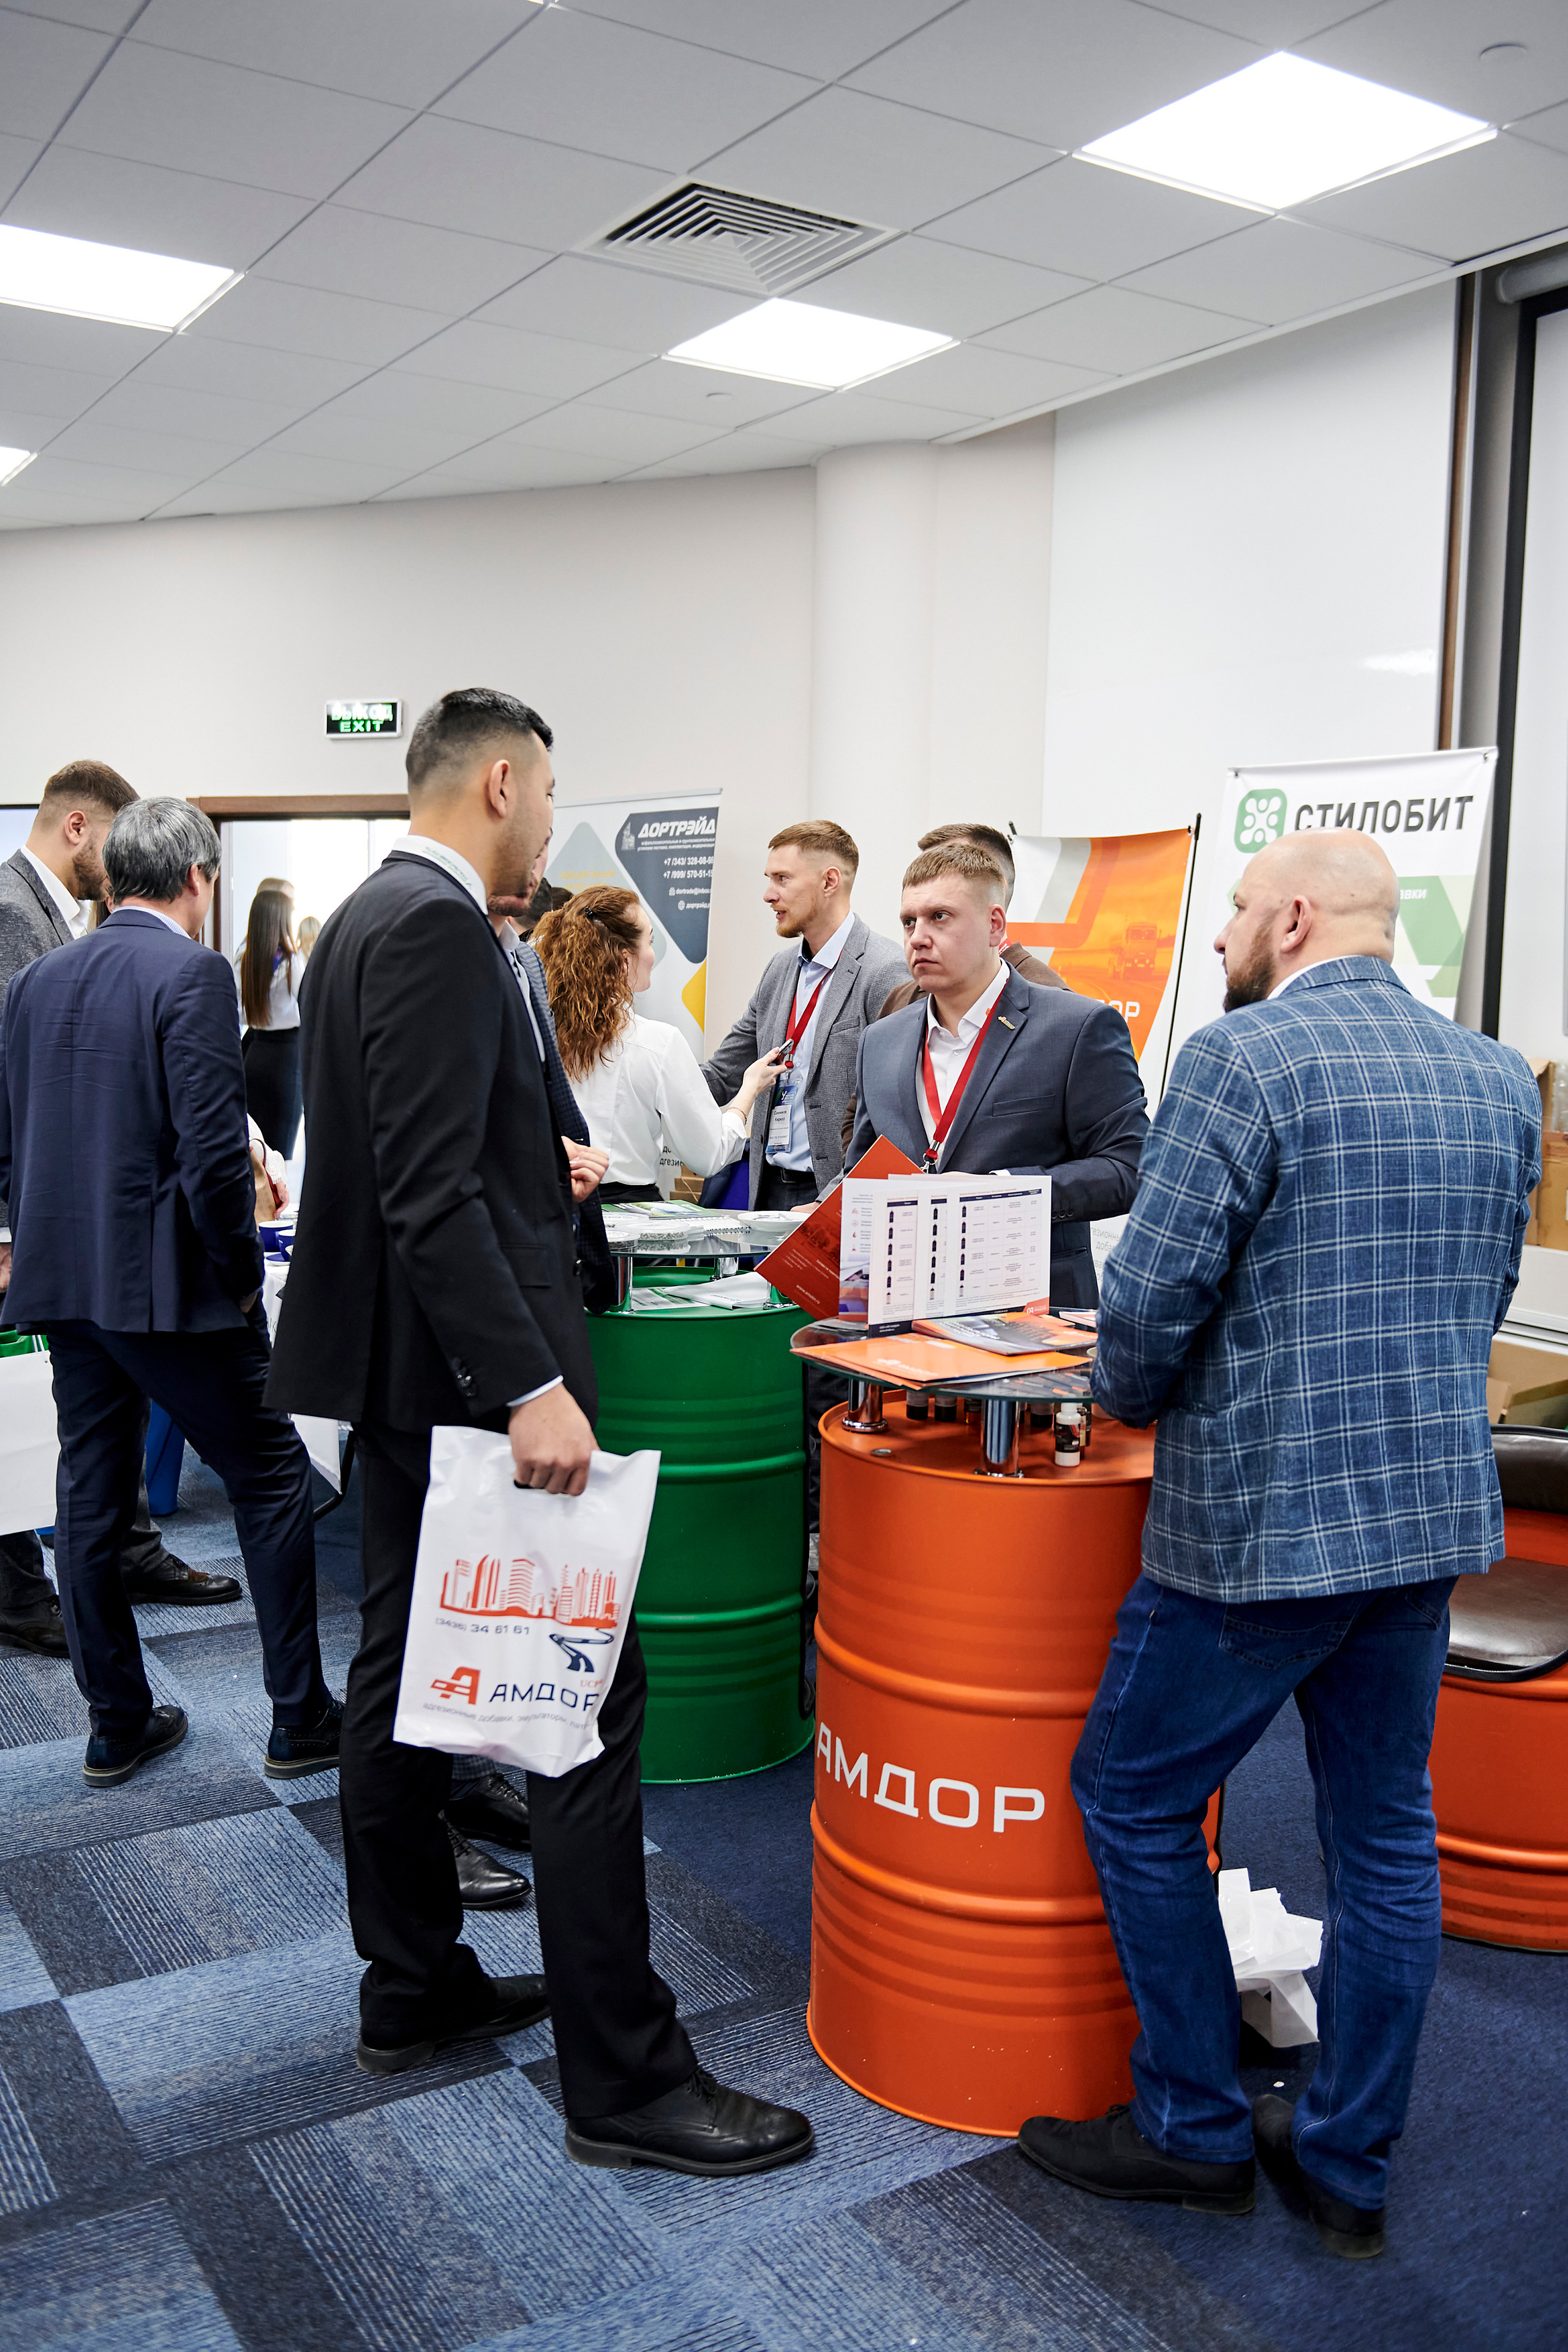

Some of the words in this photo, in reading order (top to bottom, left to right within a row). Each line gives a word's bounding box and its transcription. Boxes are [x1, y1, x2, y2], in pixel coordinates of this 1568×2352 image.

[339, 720, 383, 733] EXIT
[1295, 796, 1474, 834] СТИЛОБИТ
[638, 816, 715, 838] ДОРТРЭЙД
[559, 869, 616, 880] ОФИЦИАЛЬНЫЙ
[663, 870, 671, 879] +7
[470, 1624, 489, 1633] 34
[489, 1683, 600, 1711] АМДОР
[817, 1722, 1045, 1833] АМДОР
